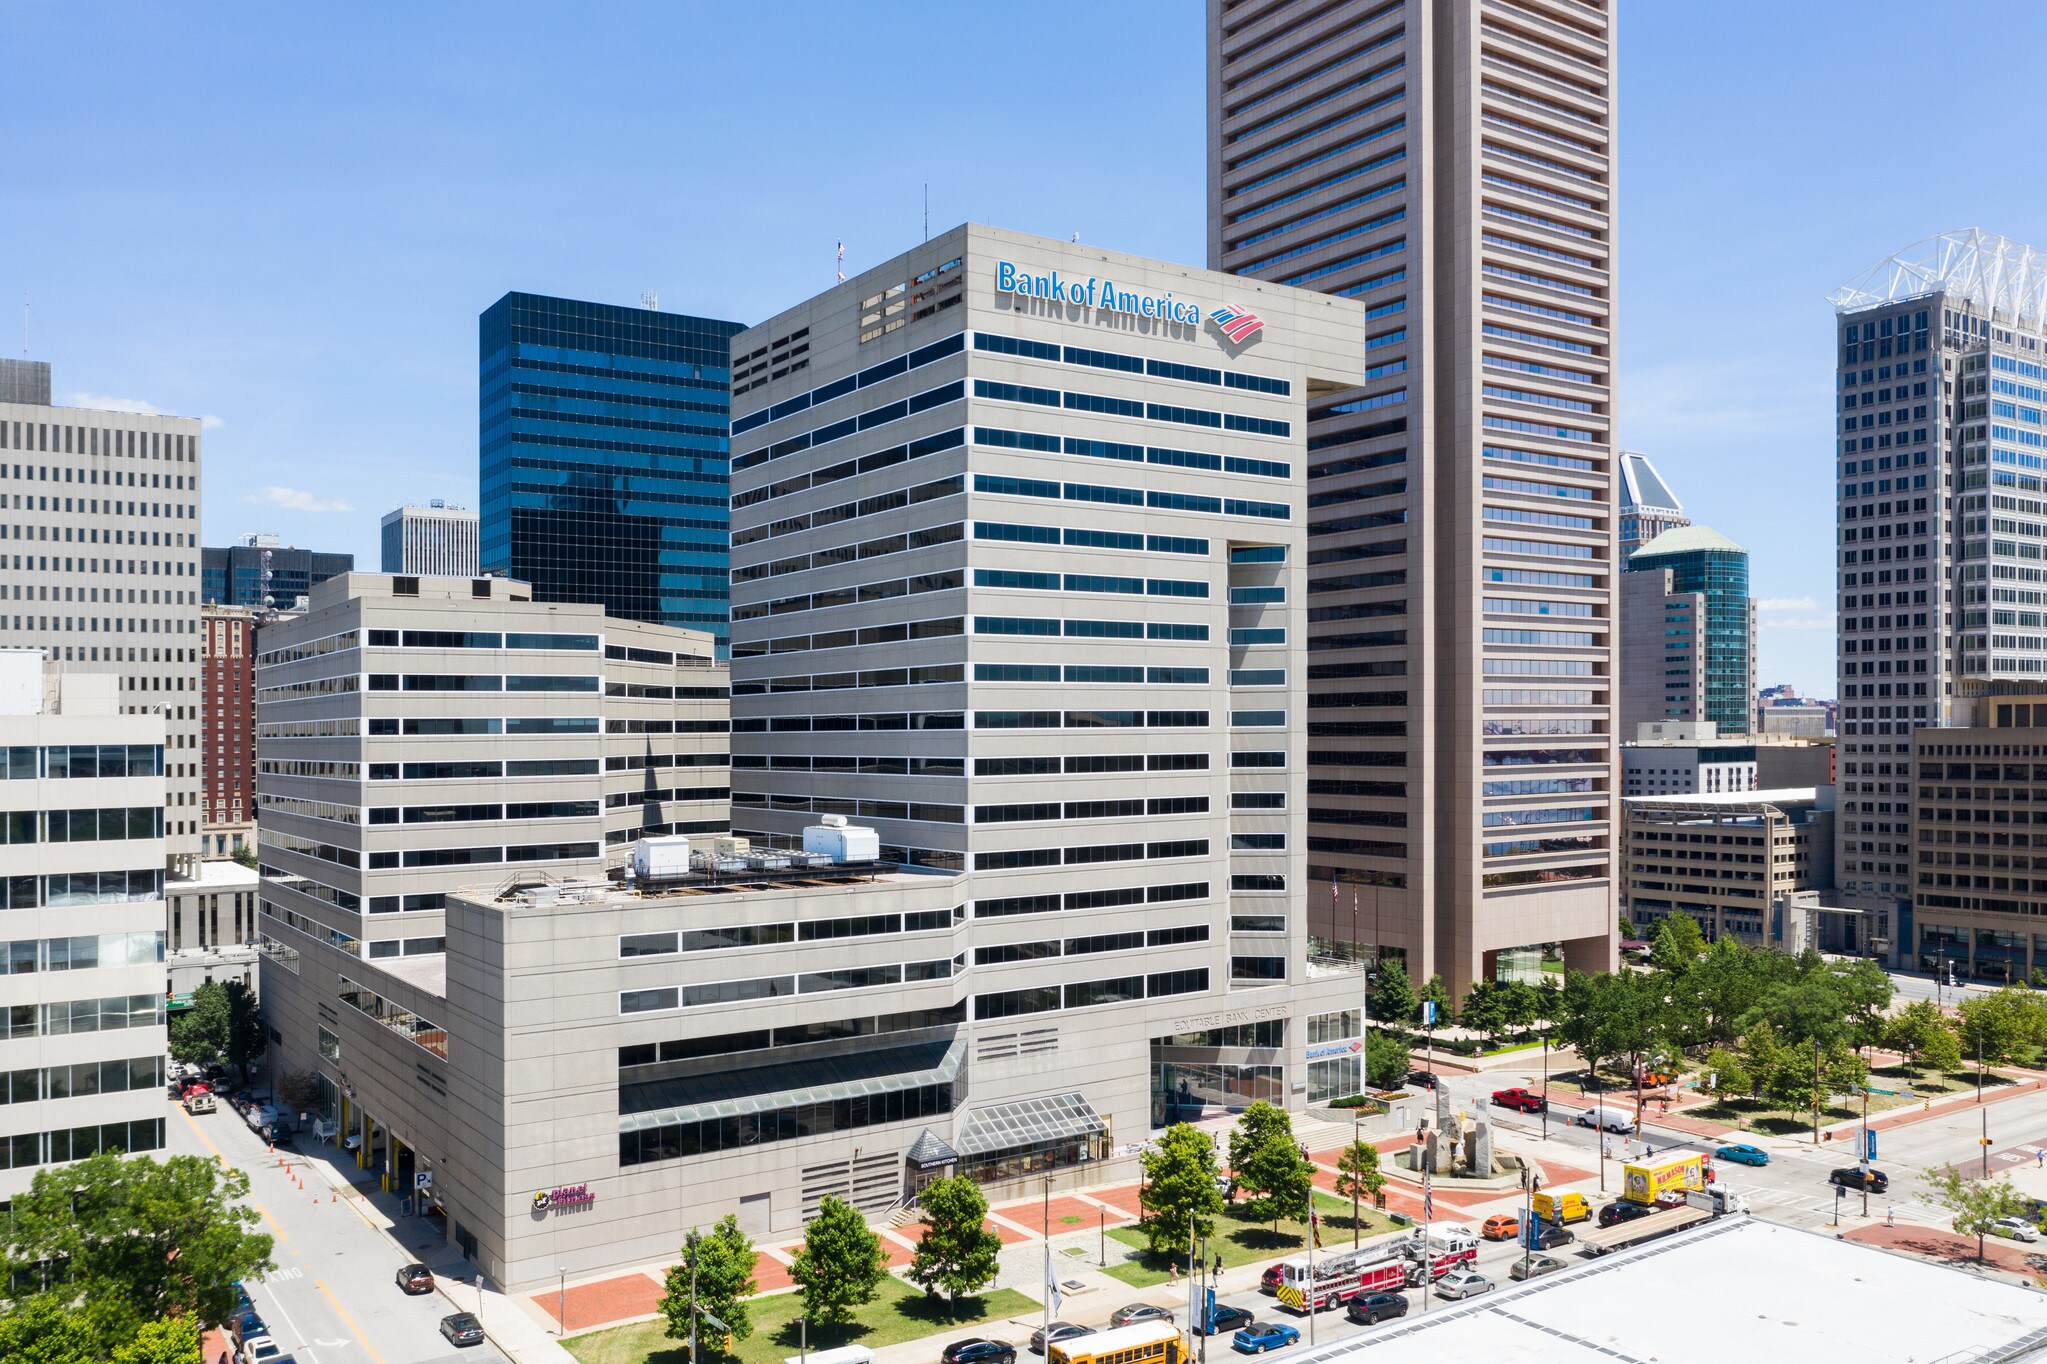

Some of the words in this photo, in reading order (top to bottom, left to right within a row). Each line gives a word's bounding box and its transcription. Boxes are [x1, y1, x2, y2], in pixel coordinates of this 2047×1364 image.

[996, 260, 1066, 301] Bank
[1069, 277, 1097, 306] of
[1099, 280, 1201, 325] America
[1174, 1015, 1221, 1031] EQUITABLE
[1225, 1011, 1249, 1024] BANK
[1254, 1005, 1287, 1019] CENTER
[1306, 1049, 1319, 1059] Bank
[1326, 1045, 1347, 1056] America
[417, 1173, 427, 1186] P
[551, 1182, 588, 1200] planet
[557, 1192, 595, 1206] fitness
[269, 1267, 304, 1283] ONLY
